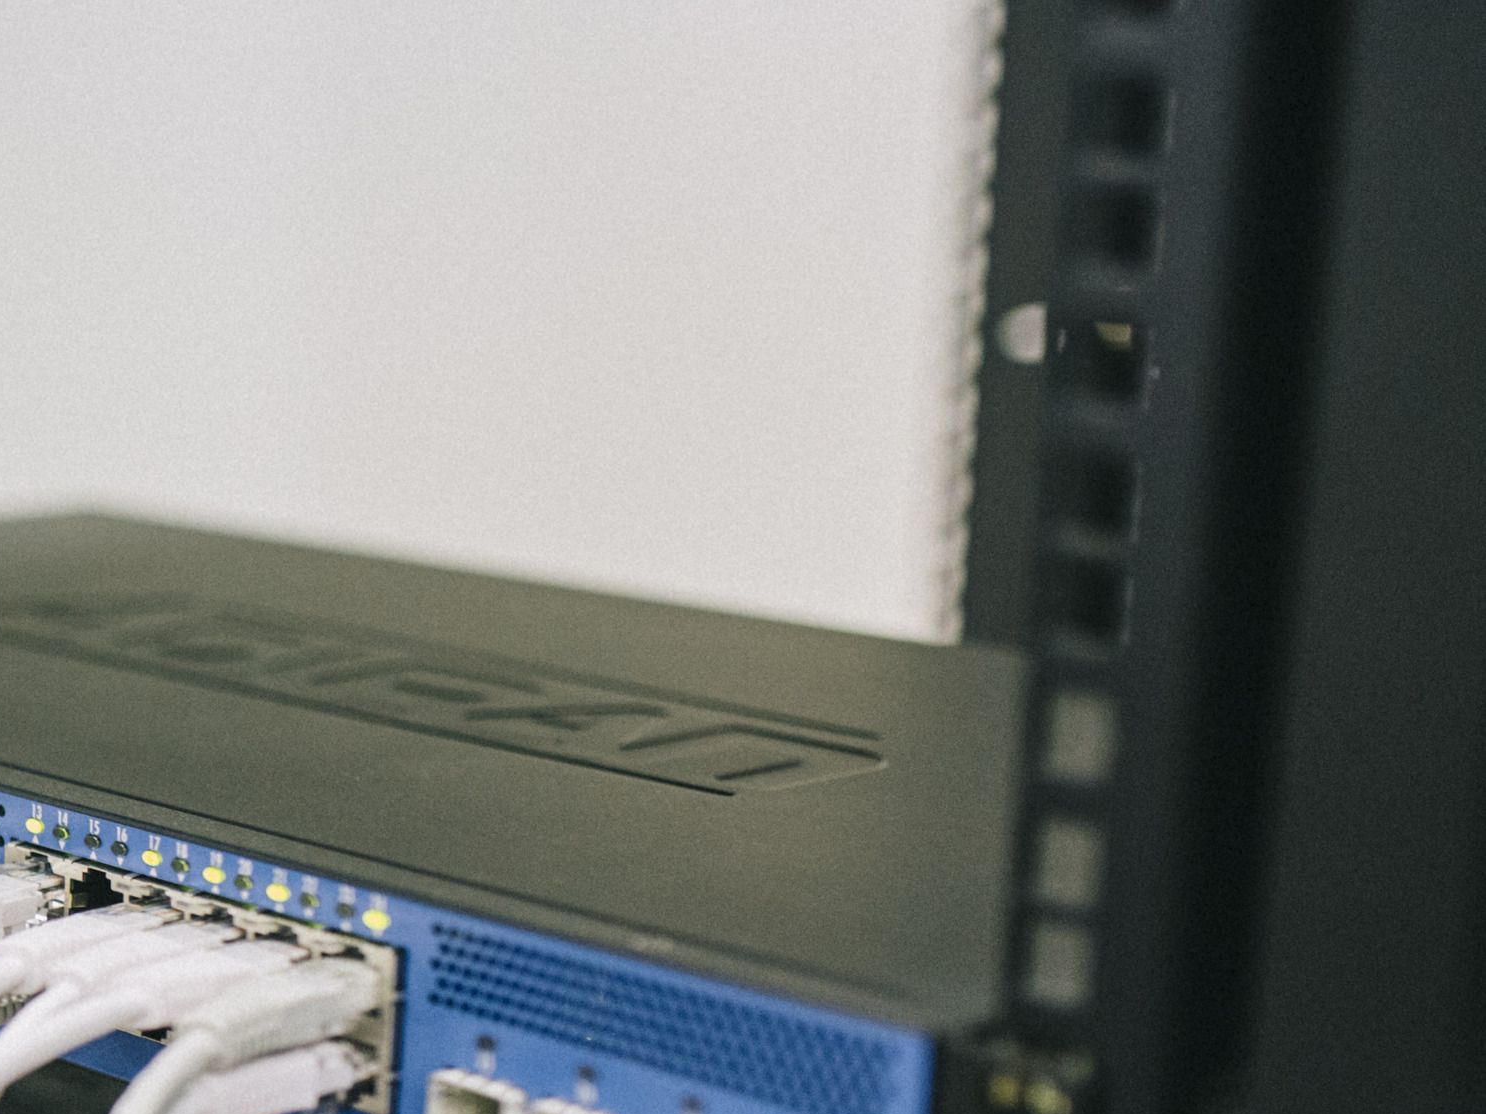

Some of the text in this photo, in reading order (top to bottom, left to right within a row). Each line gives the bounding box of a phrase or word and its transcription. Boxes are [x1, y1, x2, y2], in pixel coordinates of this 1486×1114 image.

[31, 803, 43, 819] 13
[57, 811, 69, 826] 14
[89, 819, 101, 835] 15
[116, 826, 129, 842] 16
[149, 835, 162, 850] 17
